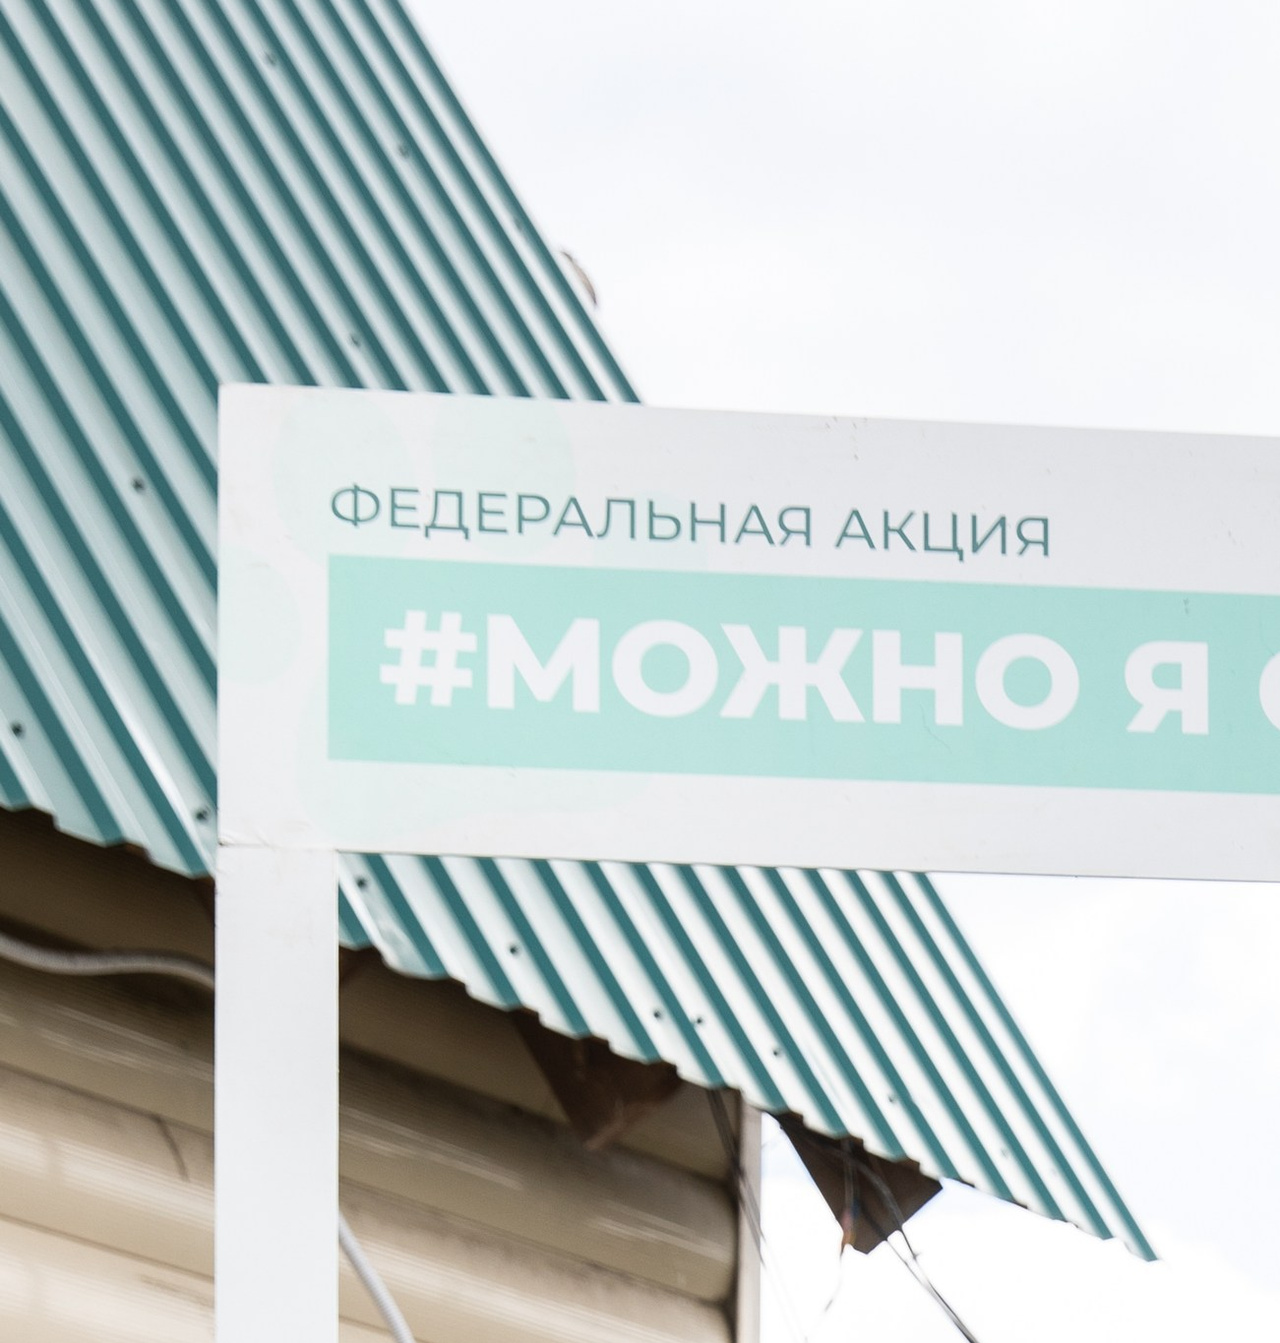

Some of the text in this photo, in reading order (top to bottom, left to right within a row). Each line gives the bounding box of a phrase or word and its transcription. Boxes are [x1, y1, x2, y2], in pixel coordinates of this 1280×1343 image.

[330, 484, 1050, 562] ФЕДЕРАЛЬНАЯ АКЦИЯ
[379, 608, 1080, 731] #МОЖНО
[1123, 639, 1210, 736] Я
